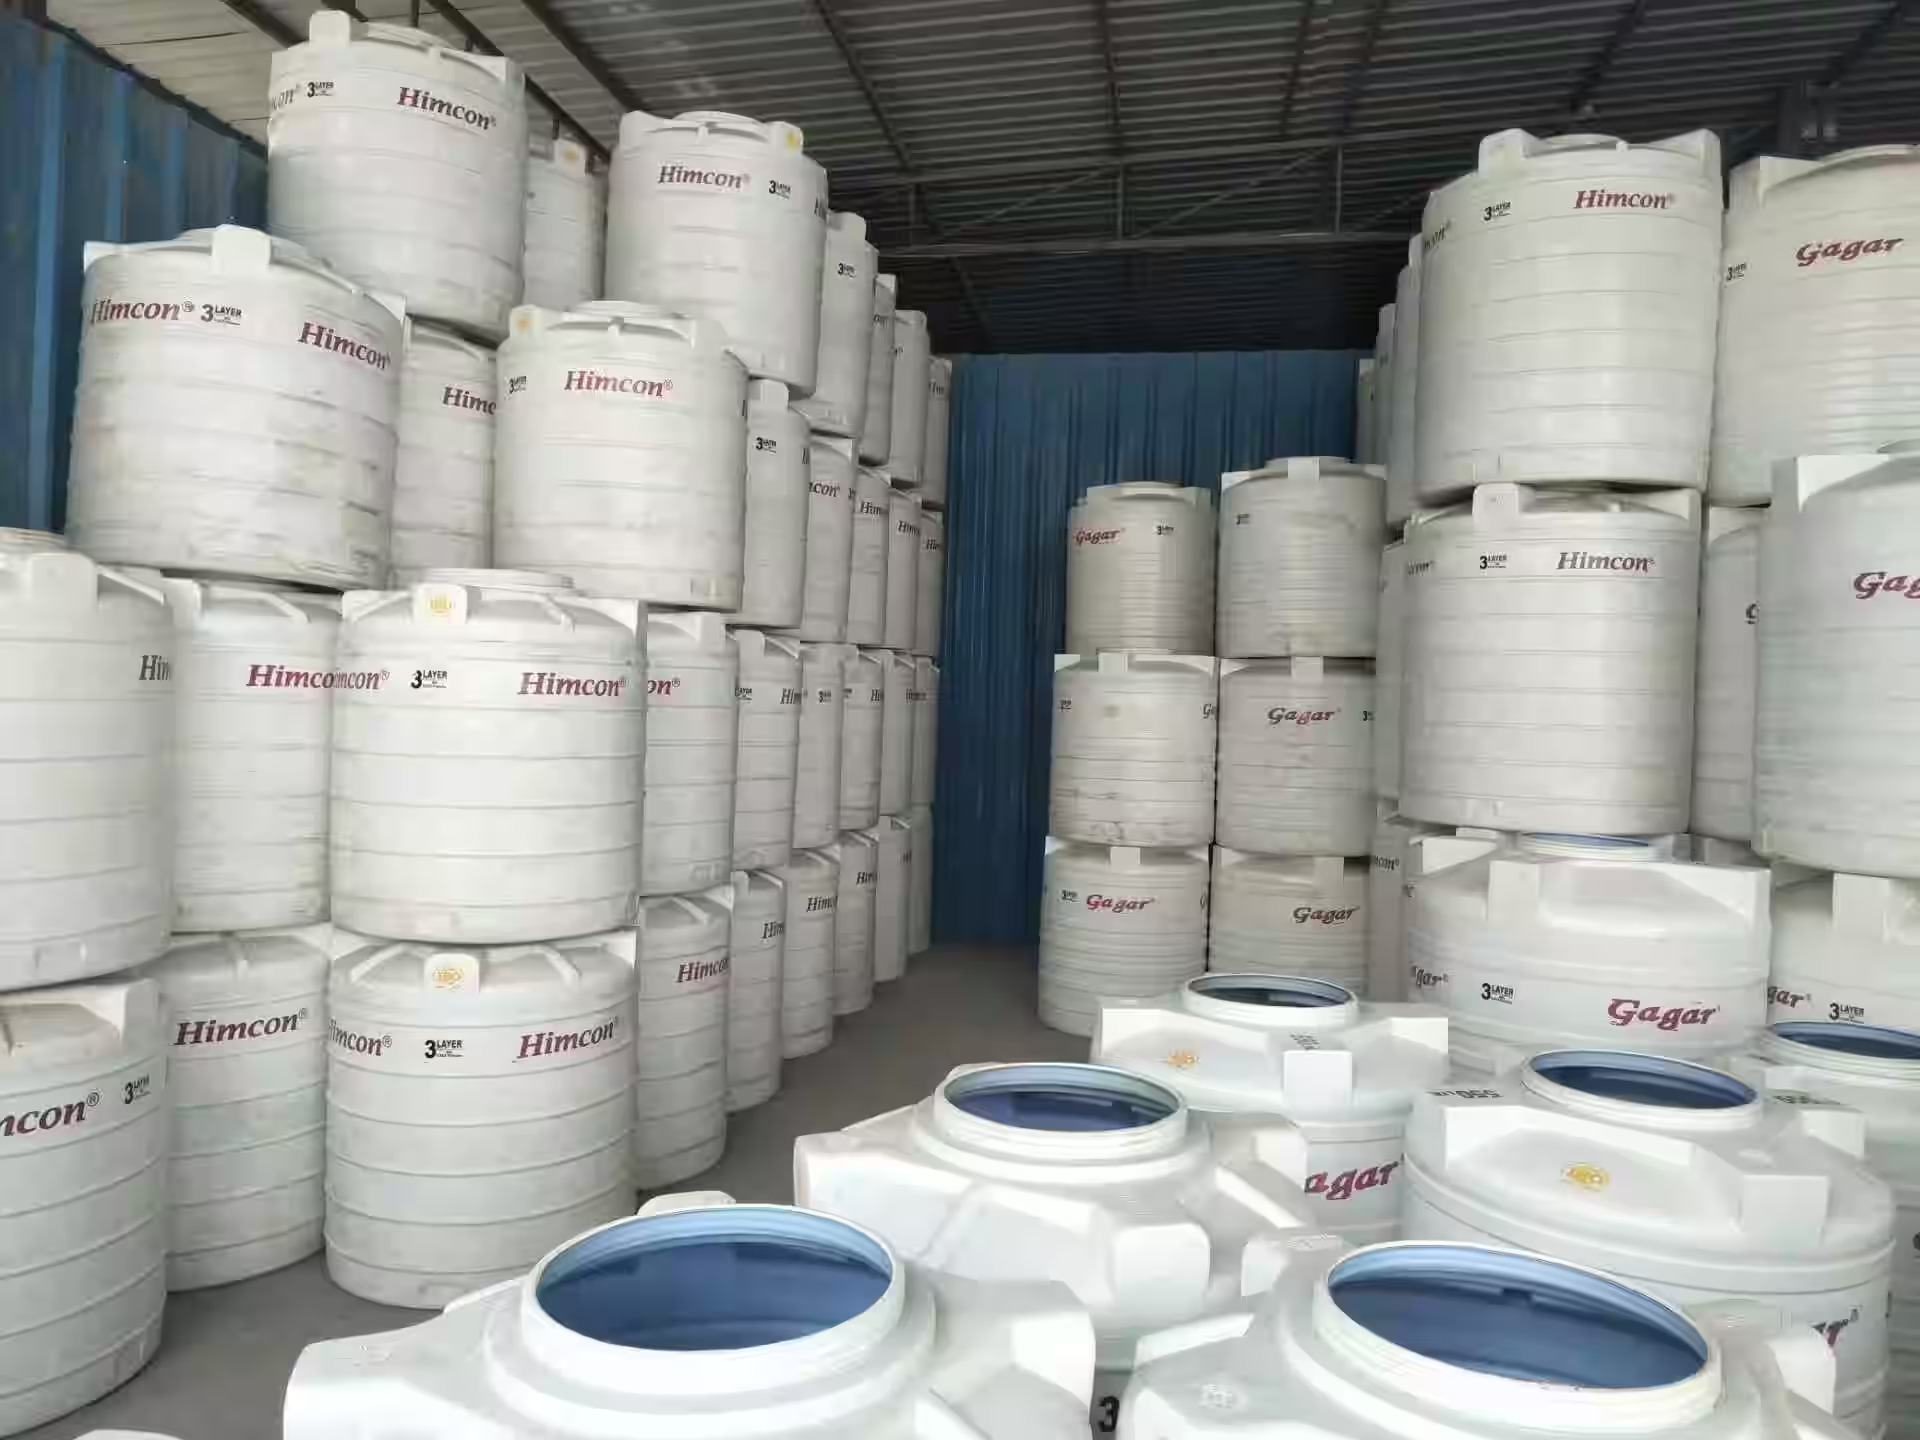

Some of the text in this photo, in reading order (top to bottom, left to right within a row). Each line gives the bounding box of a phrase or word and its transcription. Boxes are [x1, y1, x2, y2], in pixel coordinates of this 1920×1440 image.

[307, 82, 315, 98] 3
[769, 180, 776, 194] 3
[1483, 206, 1493, 222] 3
[1796, 237, 1904, 267] Gagar
[838, 263, 844, 276] 3
[1726, 266, 1733, 282] 3
[201, 304, 214, 322] 3
[215, 305, 242, 317] LAYER
[508, 378, 515, 394] 3
[442, 387, 496, 415] Himc
[756, 437, 763, 450] 3
[1480, 554, 1507, 572] 3 LAYER
[1853, 572, 1920, 599] Gag
[246, 664, 334, 689] Himco
[411, 670, 422, 689] 3
[423, 670, 447, 680] LAYER
[1267, 707, 1335, 725] Gagar
[1086, 893, 1150, 914] Gagar
[1293, 906, 1361, 924] Gagar
[1481, 983, 1513, 1001] 3 LAYER
[1830, 1002, 1864, 1020] 3 LAYER
[425, 1040, 436, 1058] 3
[437, 1040, 463, 1049] LAYER
[124, 1082, 133, 1105] 3
[1304, 1158, 1399, 1201] agar
[1099, 1396, 1119, 1432] 3
